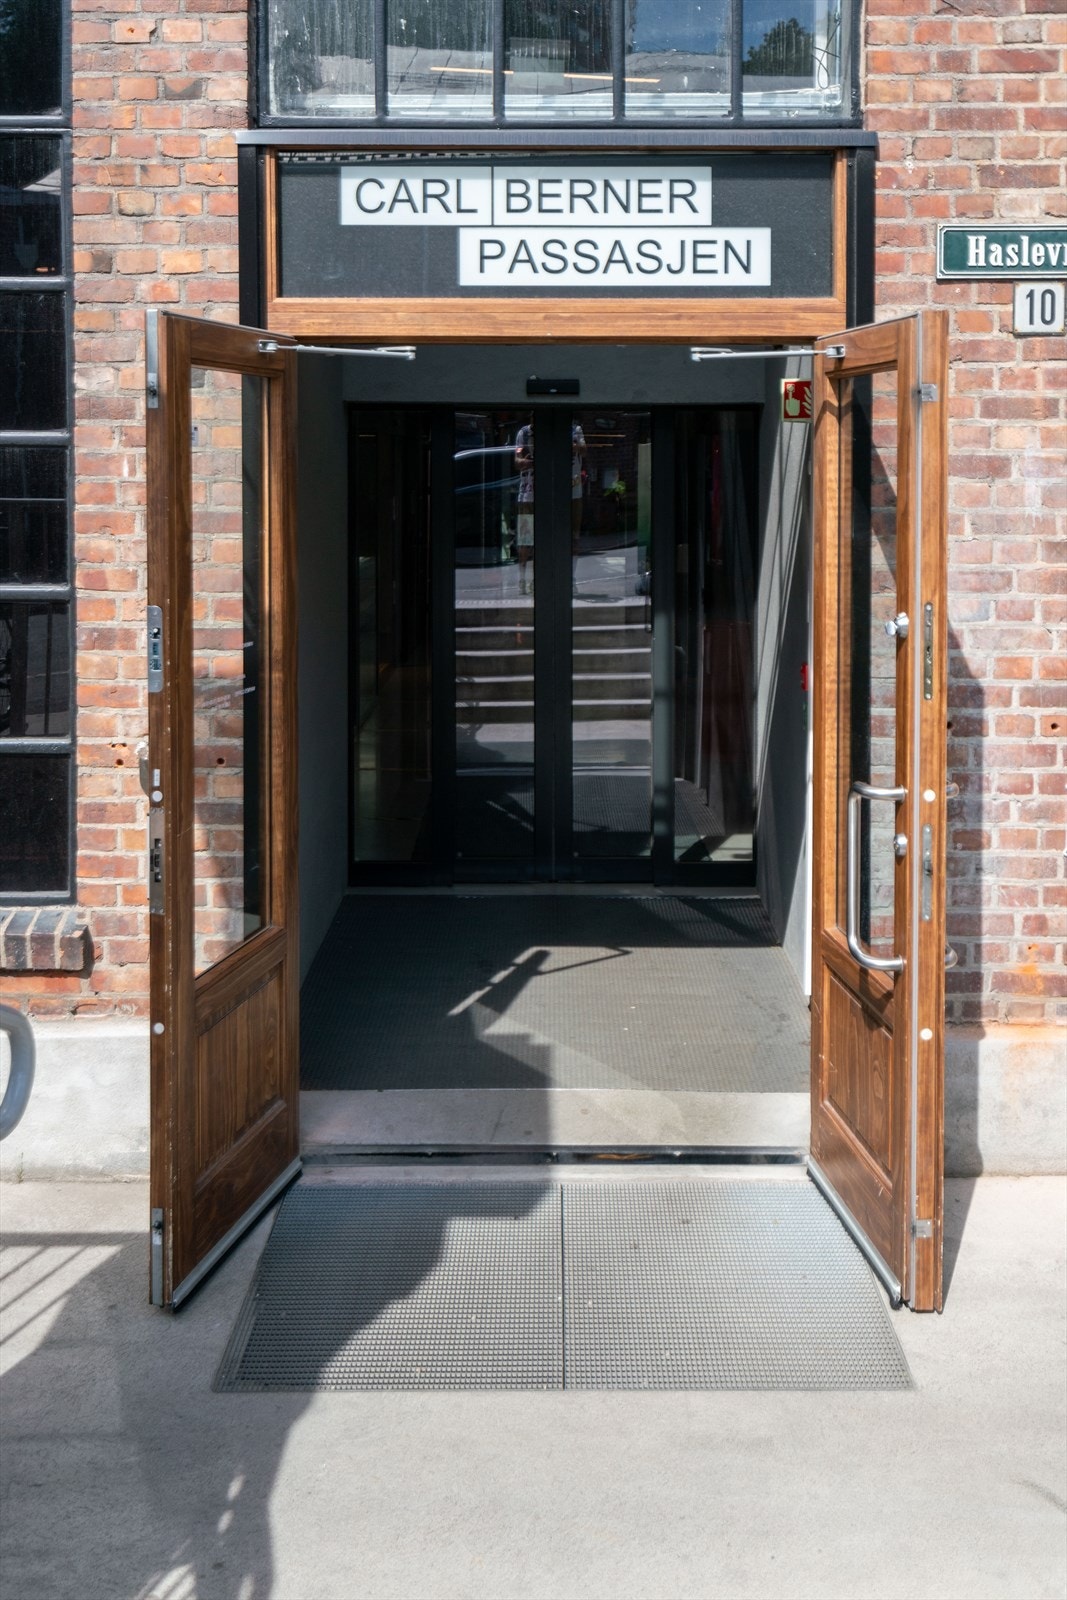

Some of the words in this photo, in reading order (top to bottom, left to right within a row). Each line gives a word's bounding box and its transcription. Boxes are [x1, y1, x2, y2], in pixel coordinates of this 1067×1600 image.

[355, 177, 479, 214] CARL
[505, 177, 699, 214] BERNER
[479, 238, 752, 275] PASSASJEN
[1026, 288, 1056, 326] 10
